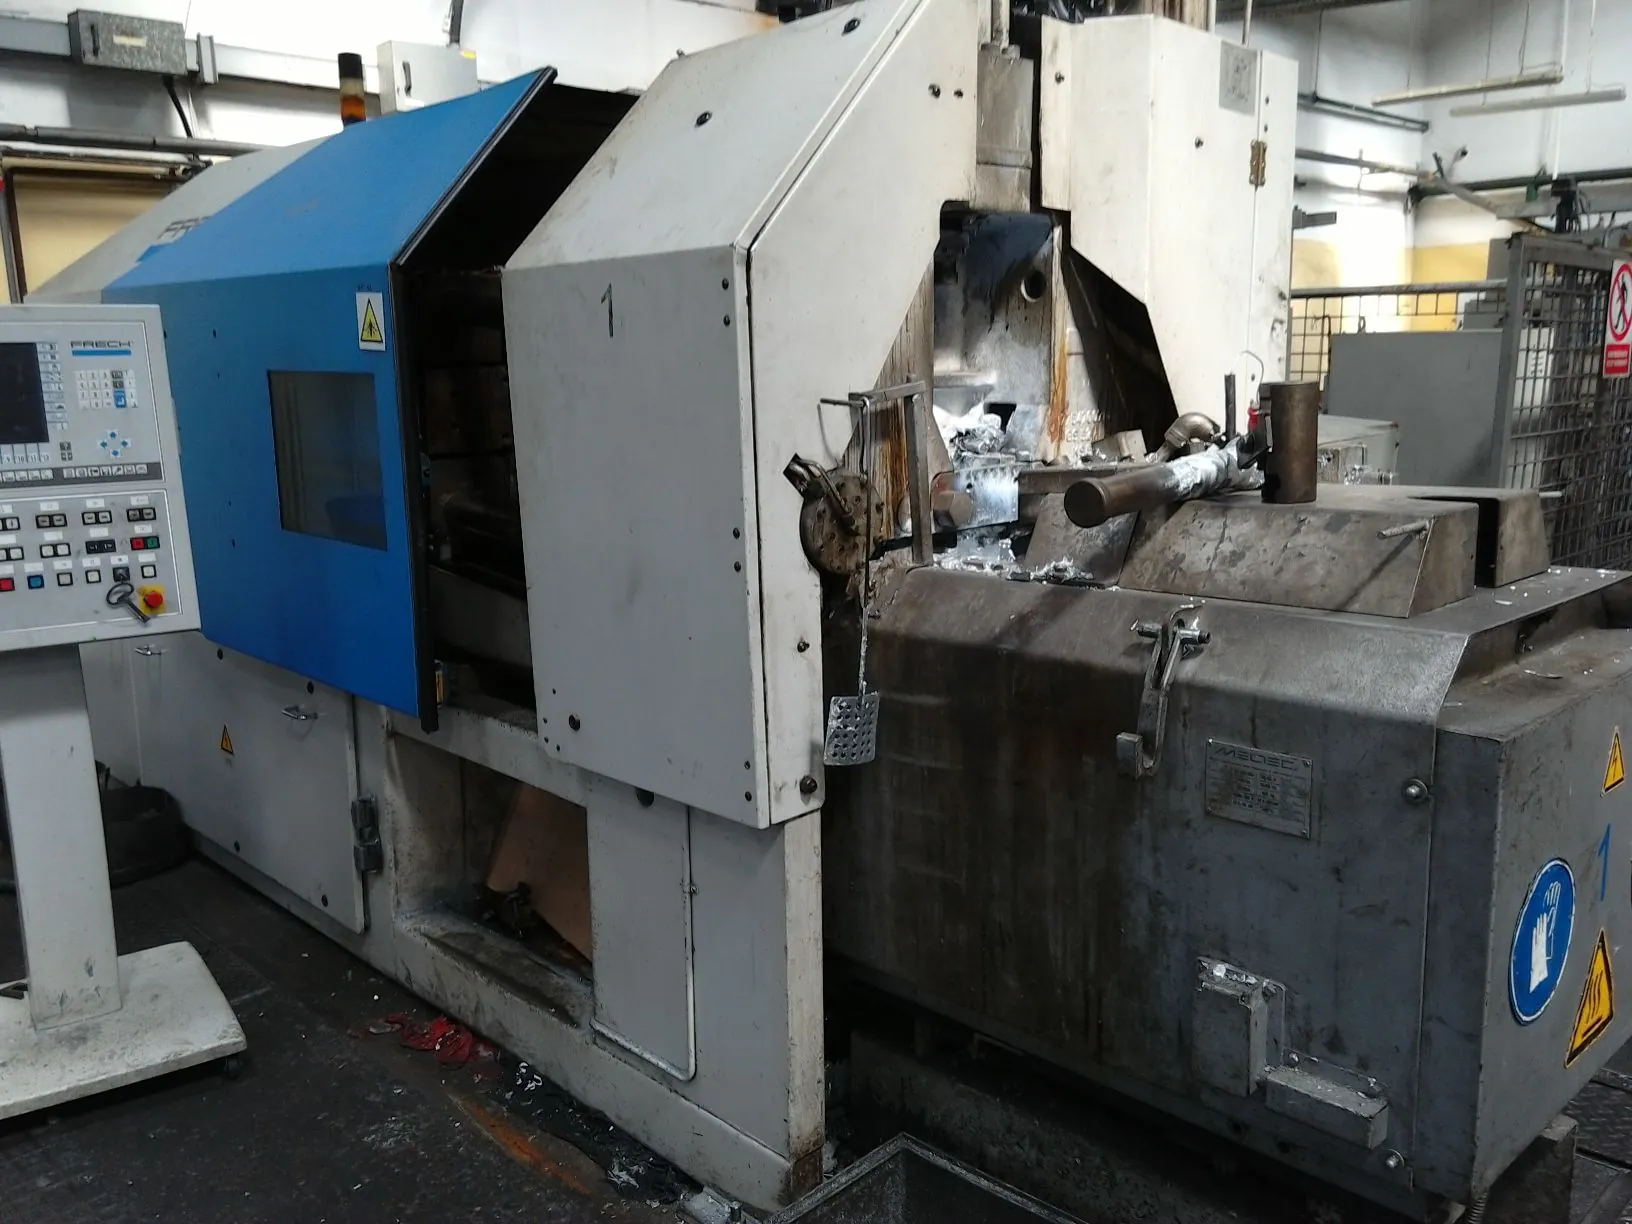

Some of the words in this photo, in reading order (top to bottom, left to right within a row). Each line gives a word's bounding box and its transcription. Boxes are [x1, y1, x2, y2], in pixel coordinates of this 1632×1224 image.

[600, 281, 614, 339] 1
[70, 340, 132, 349] FRECH
[1212, 746, 1298, 772] MEDEC
[1597, 822, 1611, 902] 1
